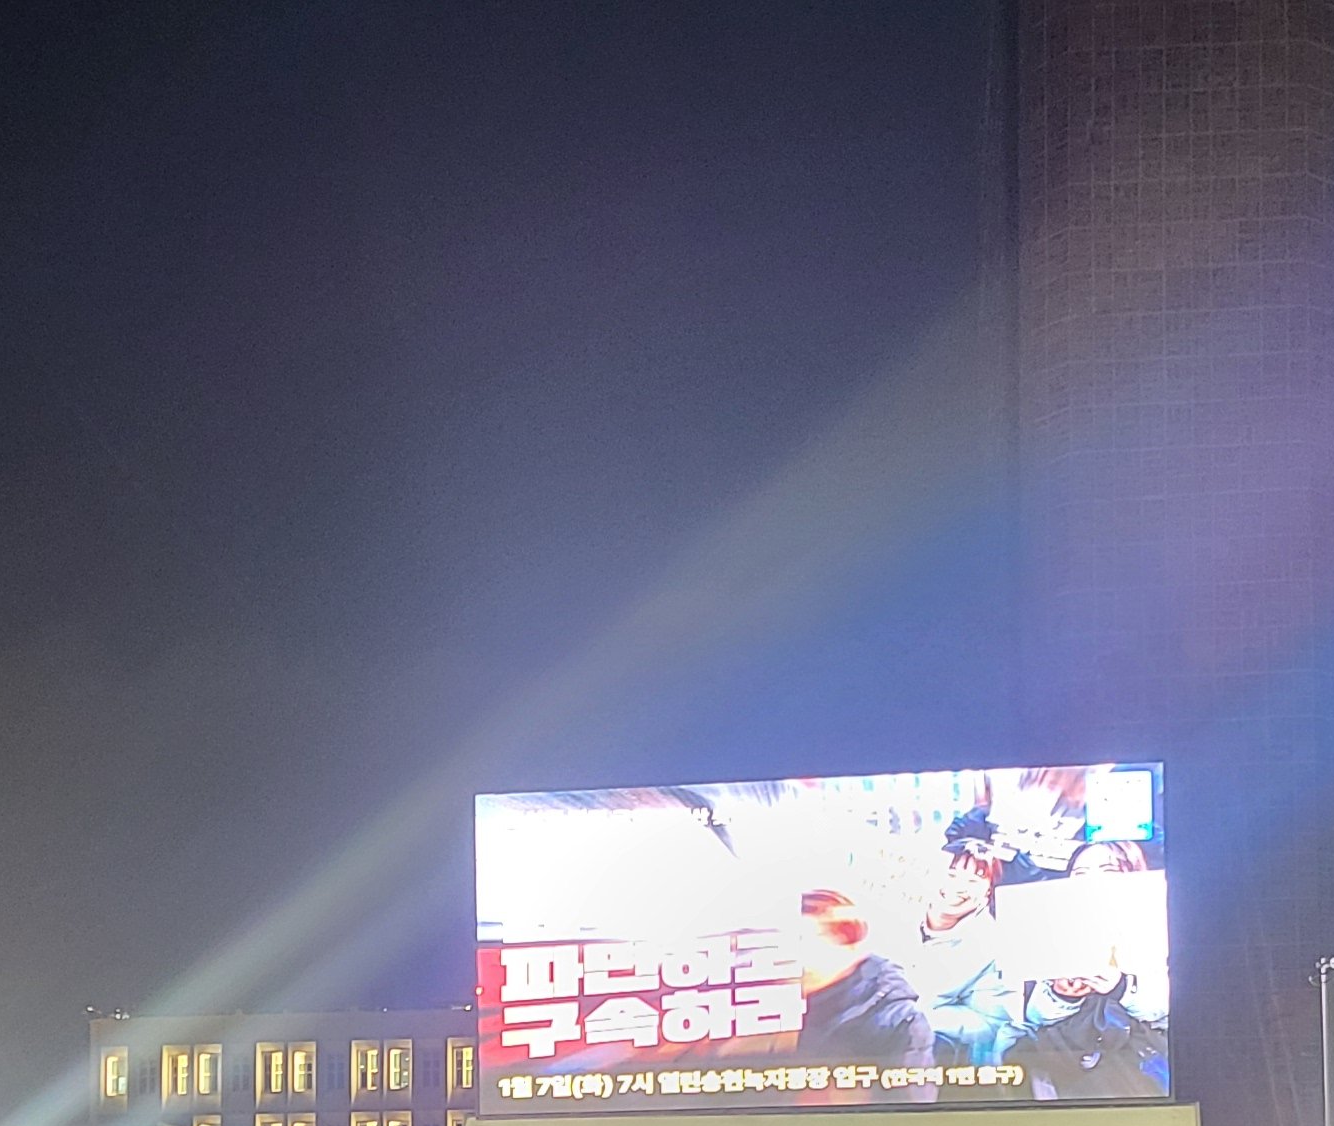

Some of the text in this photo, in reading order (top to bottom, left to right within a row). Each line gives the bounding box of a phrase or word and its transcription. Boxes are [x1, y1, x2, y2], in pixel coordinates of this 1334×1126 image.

[500, 932, 805, 1002] 파면하고
[501, 983, 808, 1058] 구속하라
[498, 1075, 533, 1098] 1월
[535, 1073, 614, 1099] 7일(화)
[617, 1072, 654, 1095] 7시
[833, 1065, 879, 1089] 입구
[977, 1065, 1024, 1086] 출구)
